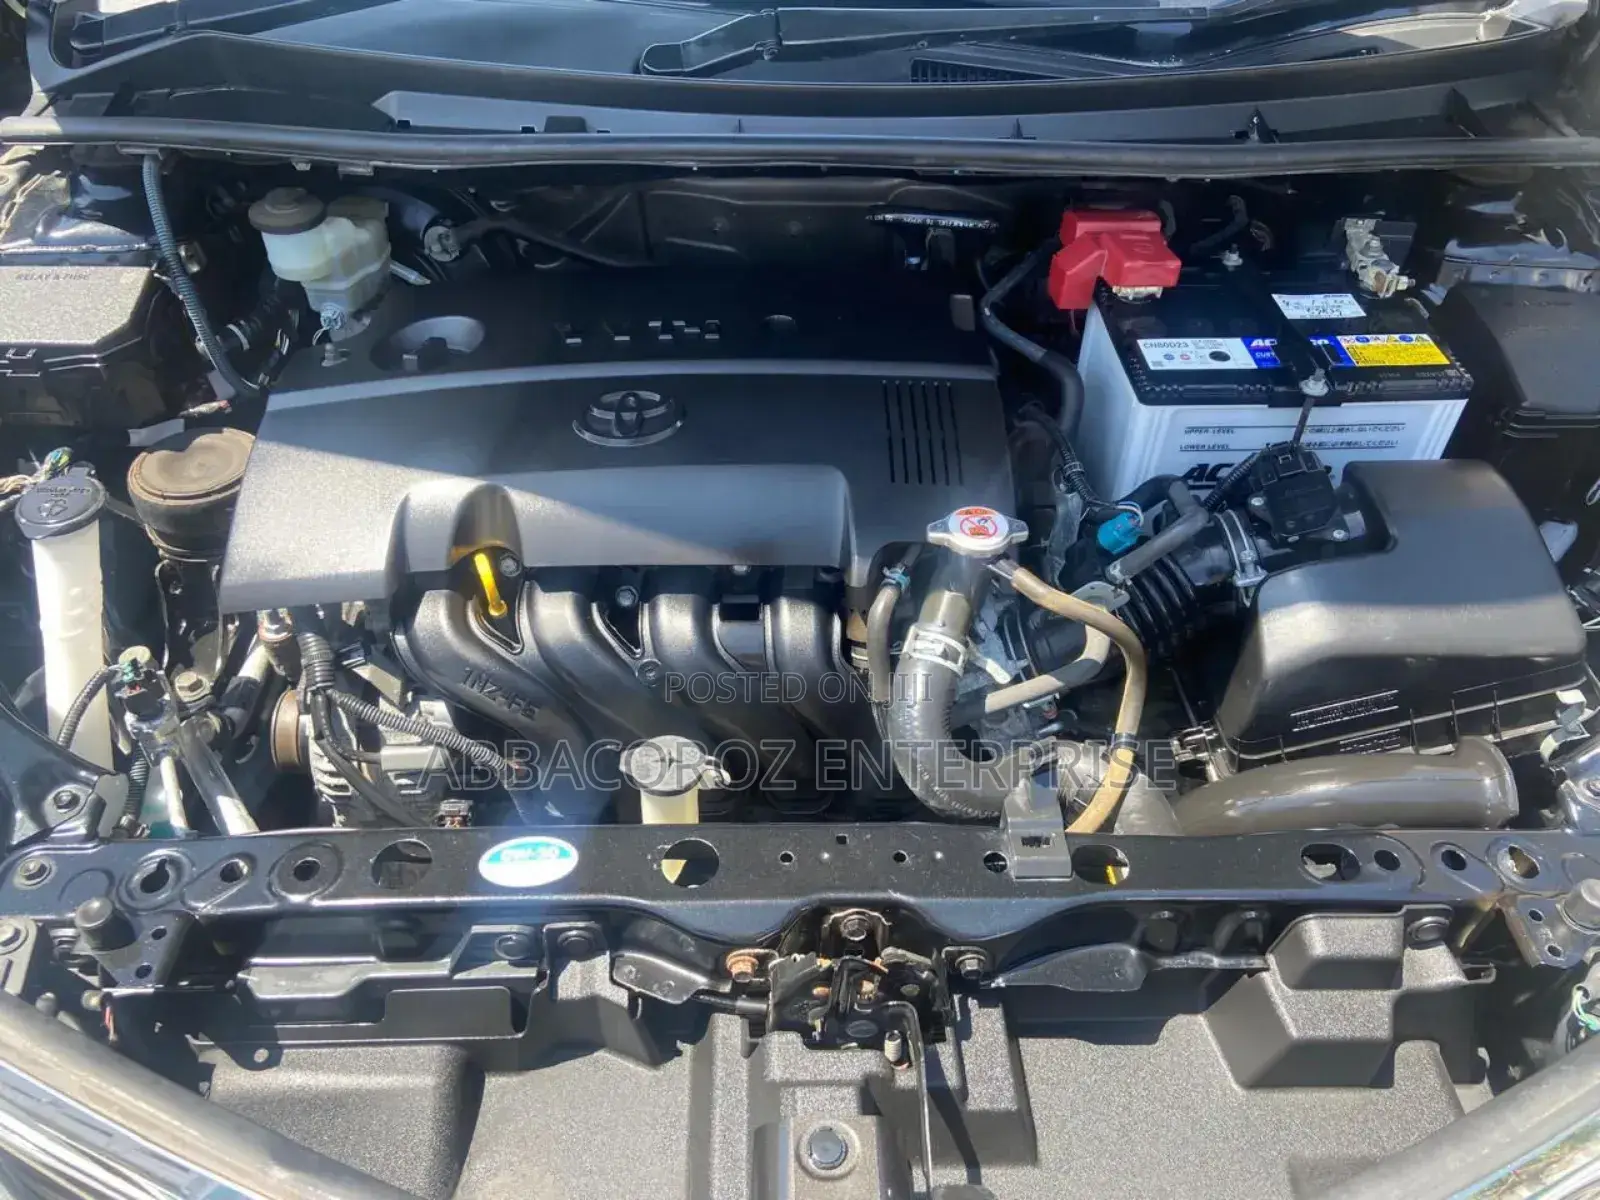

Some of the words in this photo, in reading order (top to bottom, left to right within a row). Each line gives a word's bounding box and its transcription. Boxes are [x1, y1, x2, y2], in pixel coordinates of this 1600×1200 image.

[1184, 428, 1210, 436] UPPER
[1179, 443, 1206, 451] LOWER
[1207, 443, 1231, 451] LEVEL
